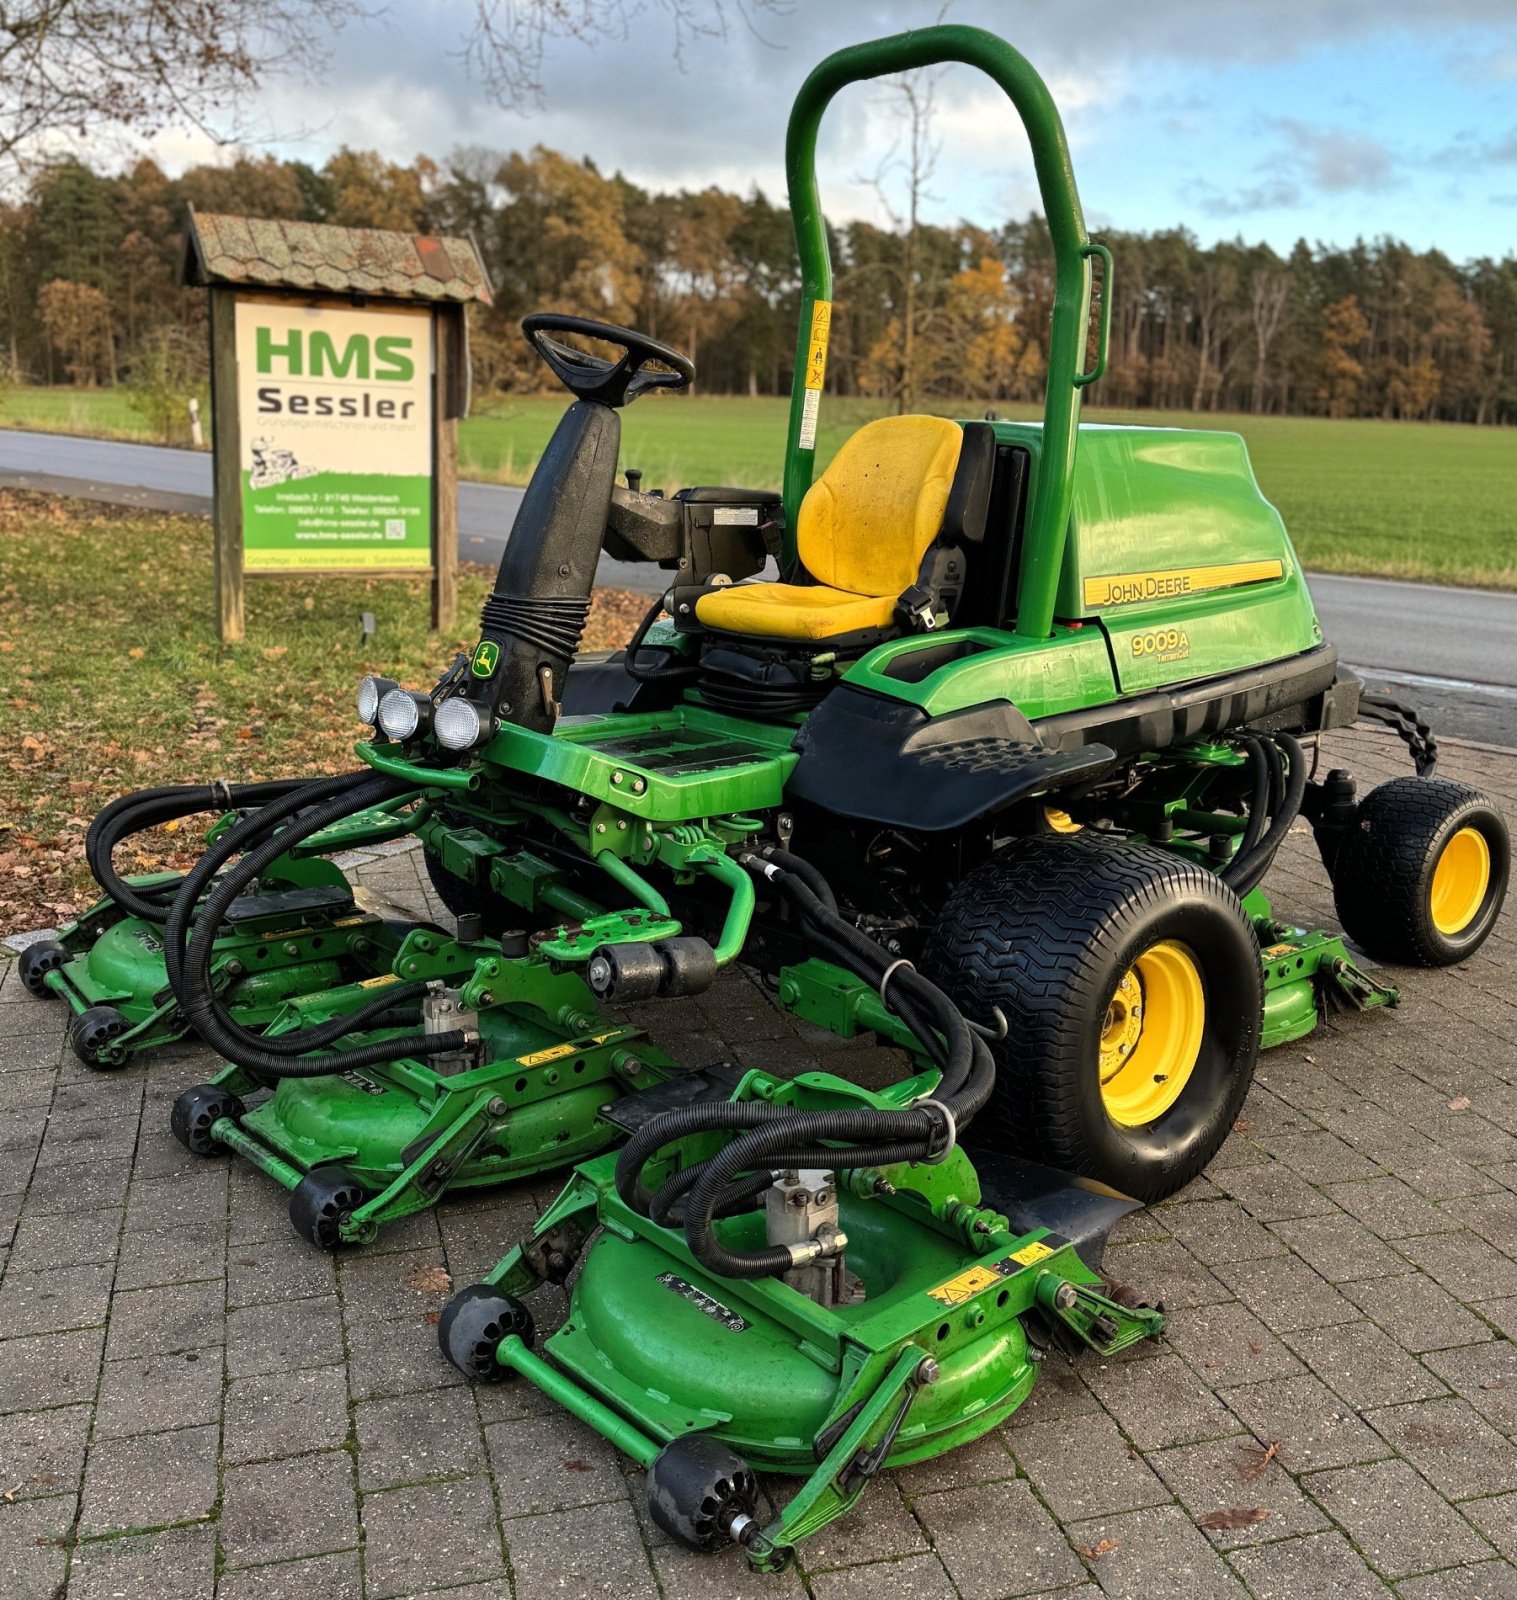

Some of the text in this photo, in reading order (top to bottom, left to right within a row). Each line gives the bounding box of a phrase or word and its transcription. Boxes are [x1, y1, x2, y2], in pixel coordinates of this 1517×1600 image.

[256, 327, 414, 381] HMS
[258, 388, 414, 419] Sessler
[1104, 577, 1190, 603] JOHN DEERE
